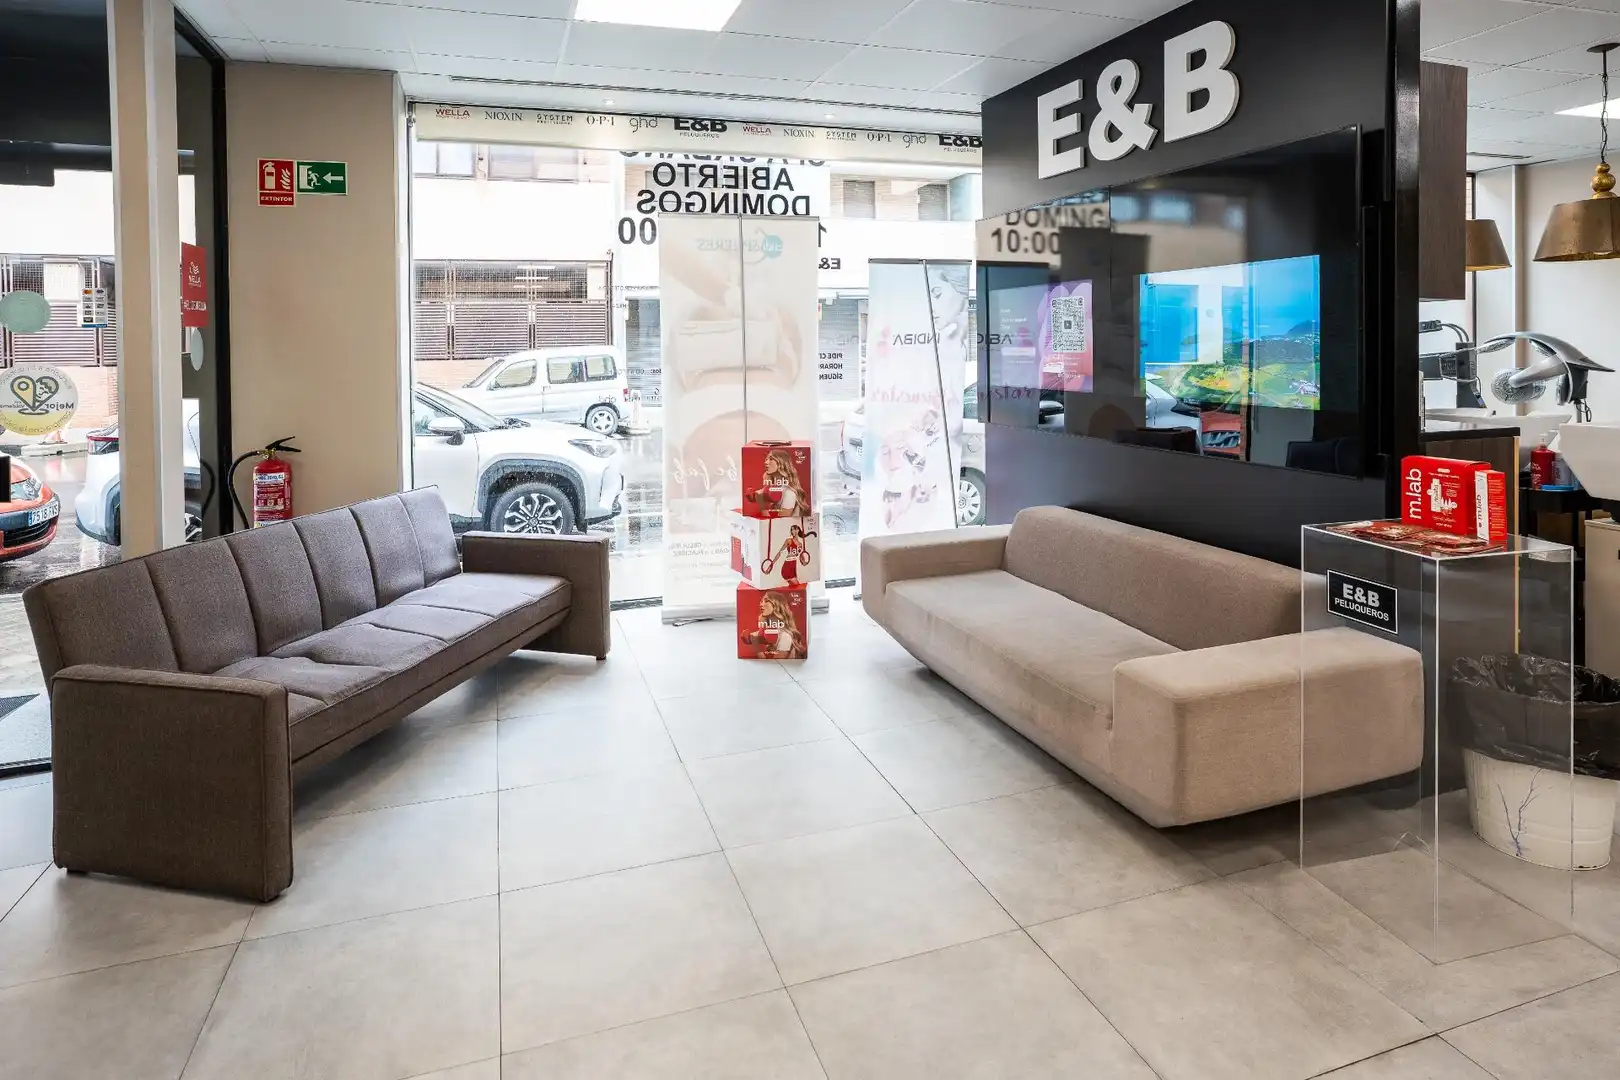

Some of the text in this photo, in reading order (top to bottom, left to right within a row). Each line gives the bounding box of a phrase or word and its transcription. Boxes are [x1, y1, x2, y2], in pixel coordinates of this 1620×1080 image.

[1037, 20, 1240, 179] E&B
[435, 108, 470, 117] WELLA
[484, 111, 524, 121] NIOXIN
[536, 113, 573, 121] SYSTEM
[629, 116, 658, 133] ghd
[673, 117, 728, 133] E&B
[742, 126, 772, 134] WELLA
[783, 128, 815, 138] NIOXIN
[826, 130, 857, 138] SYSTEM
[902, 134, 927, 149] ghd
[939, 133, 982, 148] E&B
[260, 195, 293, 203] EXTINTOR
[1405, 468, 1422, 520] m.lab
[1342, 582, 1380, 608] E&B
[1334, 597, 1390, 622] PELUQUEROS
[758, 619, 786, 629] m.lab
